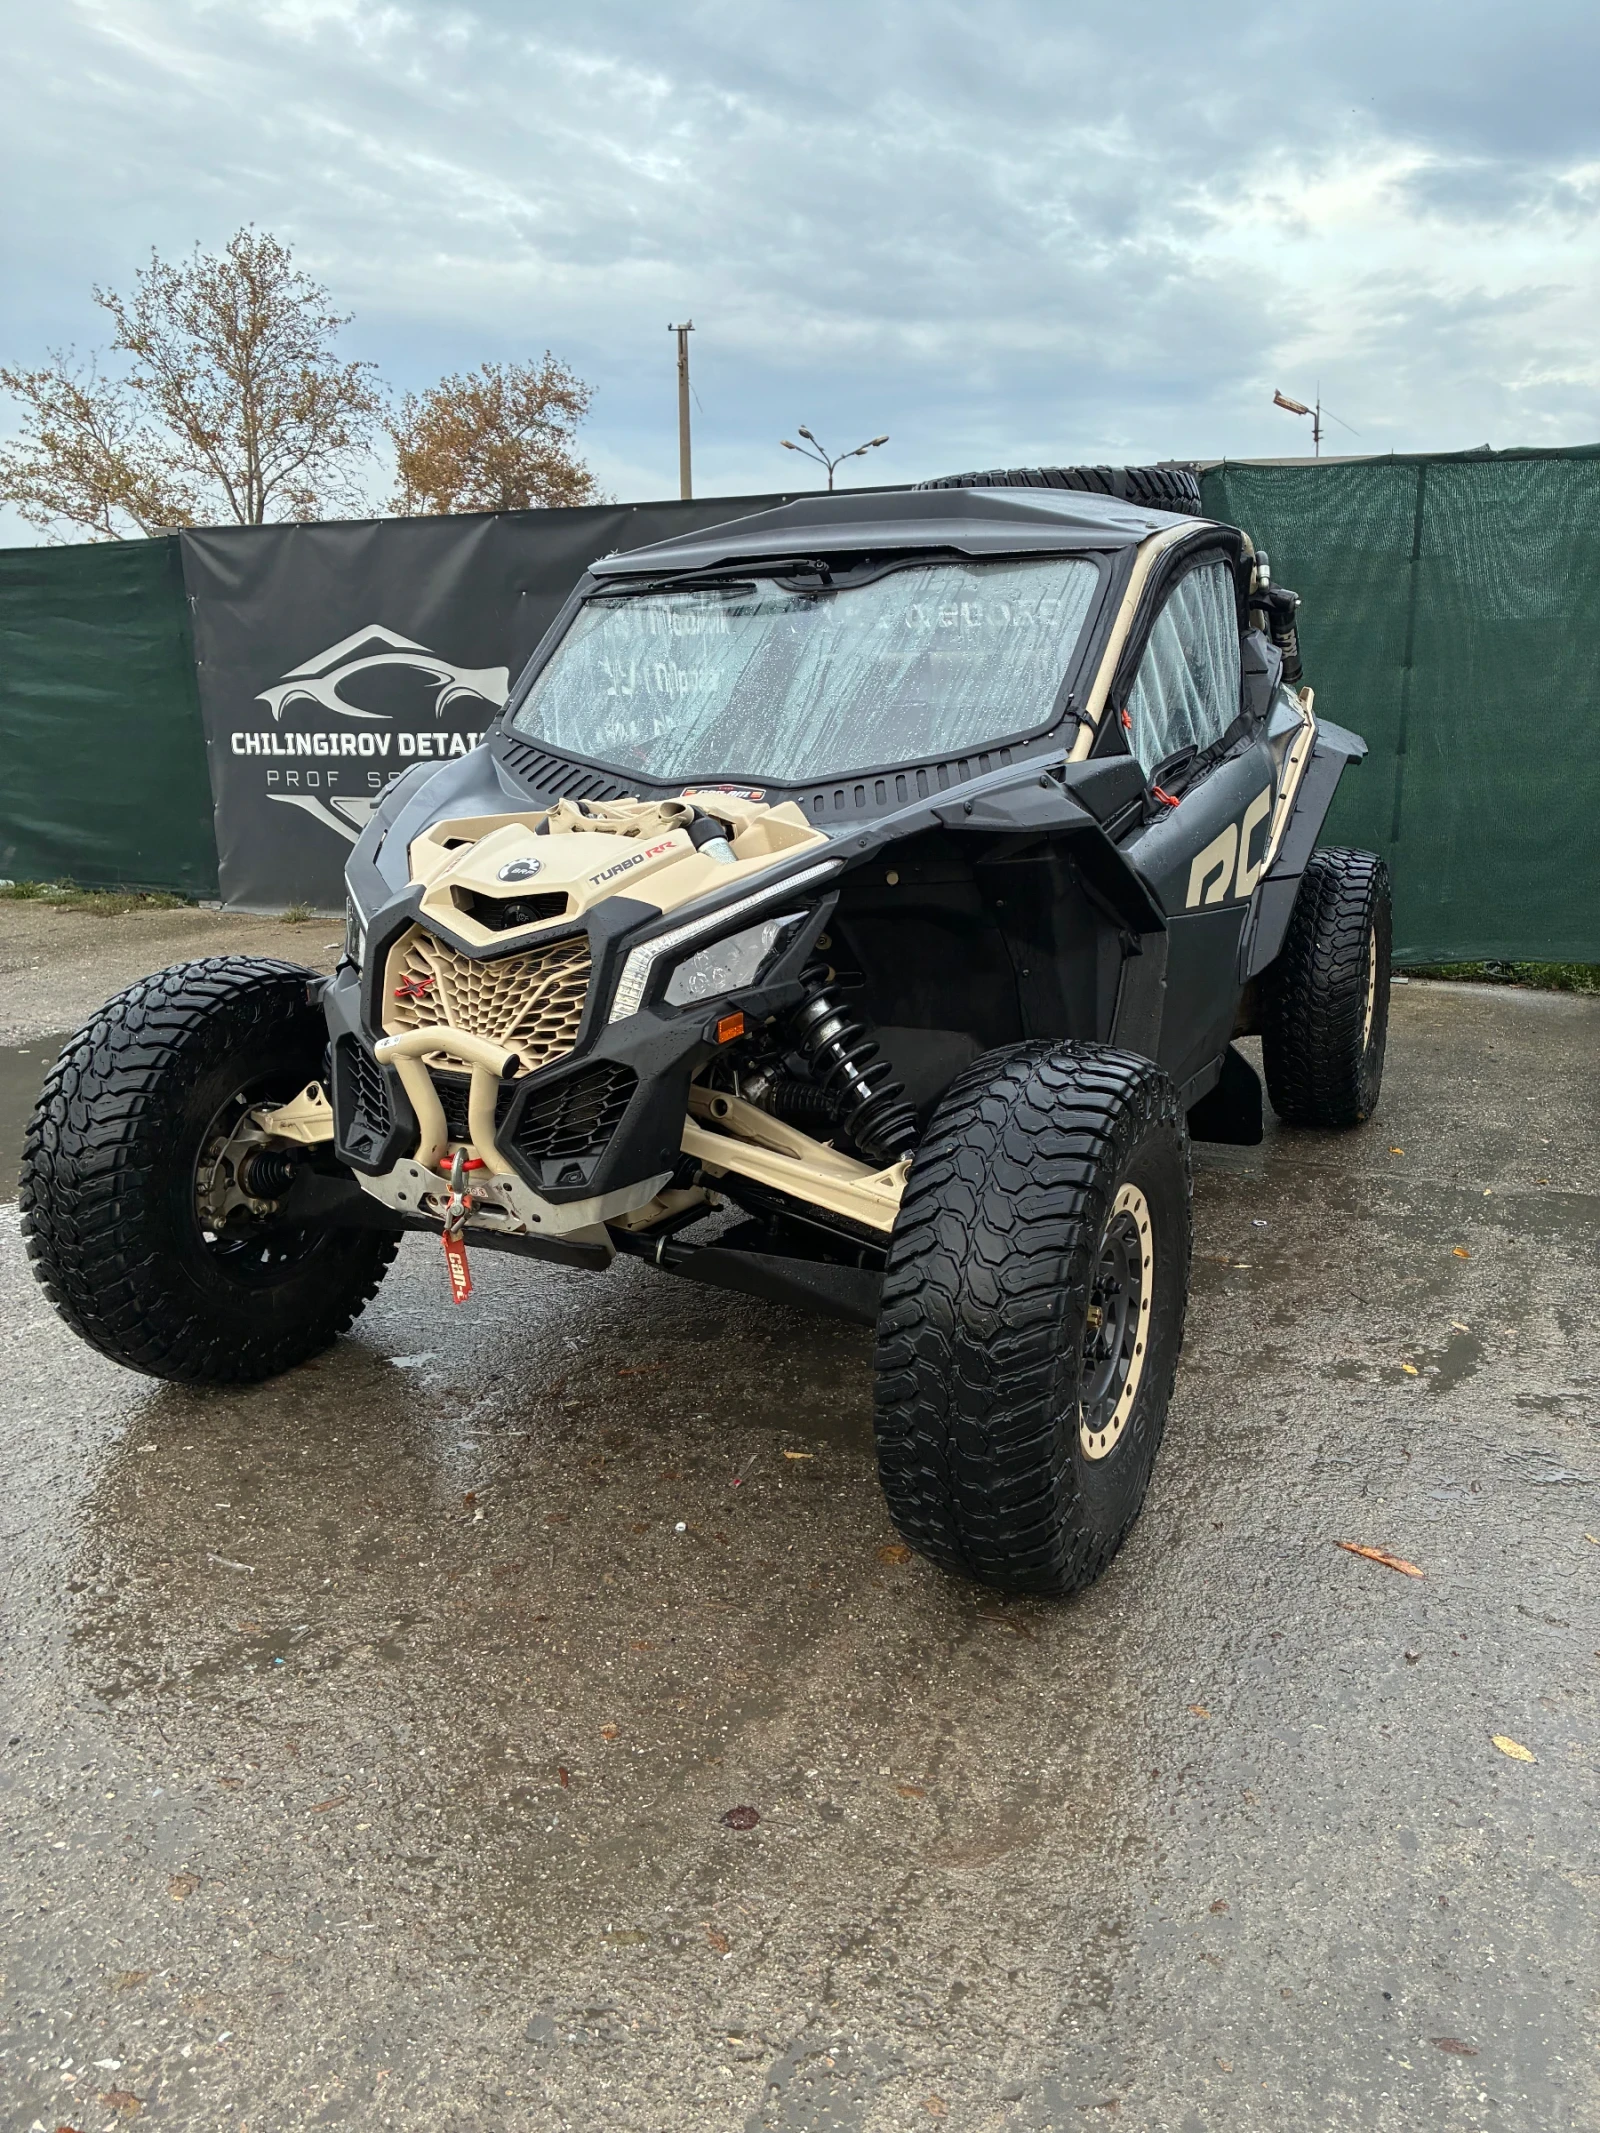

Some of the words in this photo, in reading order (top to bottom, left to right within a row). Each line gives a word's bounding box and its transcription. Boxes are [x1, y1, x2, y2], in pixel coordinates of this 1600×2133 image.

[231, 732, 392, 756] CHILINGIROV
[266, 770, 340, 787] PROF
[510, 867, 535, 875] BRP
[589, 853, 645, 886] TURBO
[645, 841, 678, 859] RR
